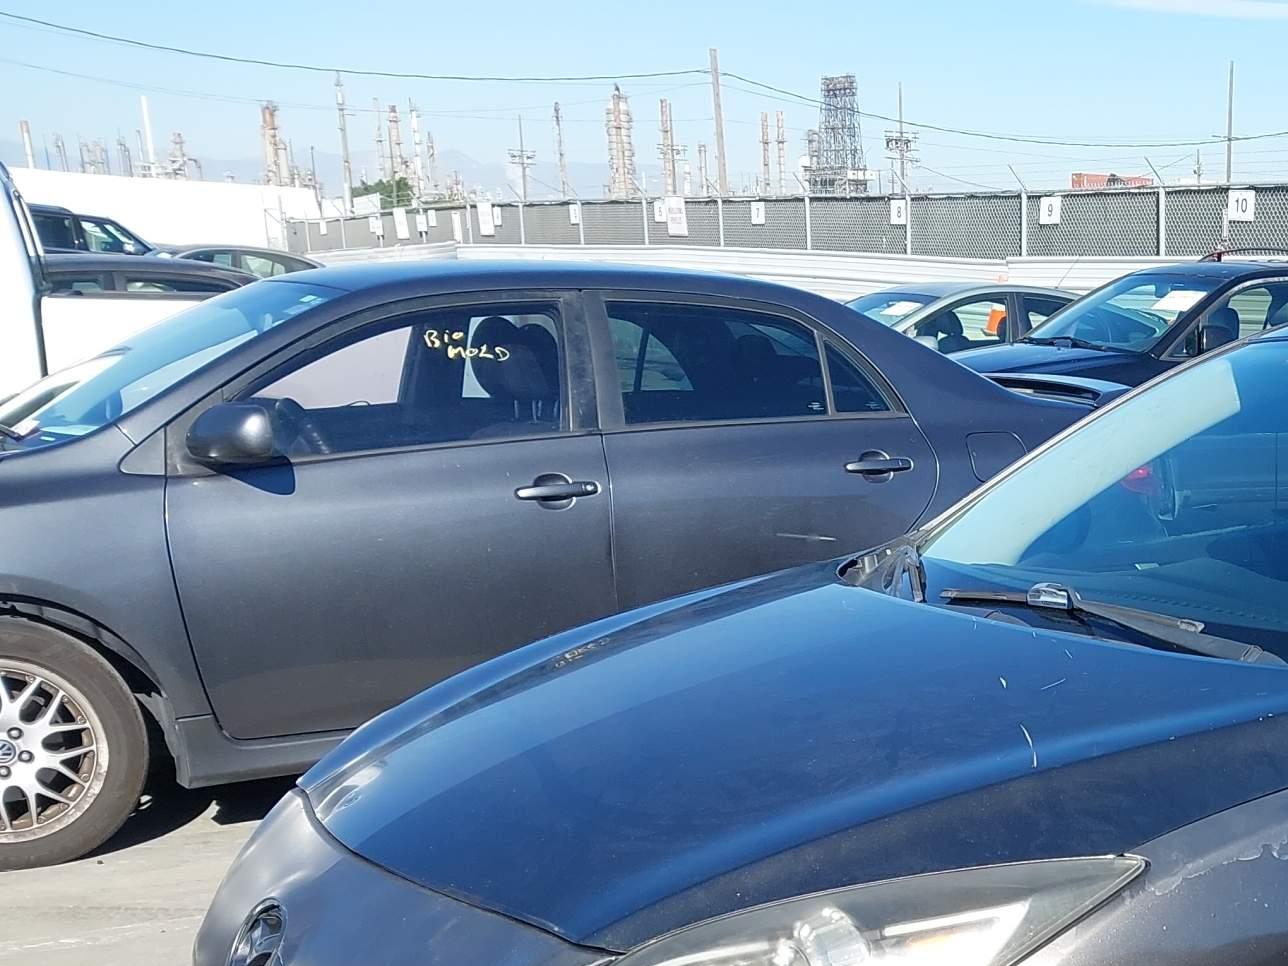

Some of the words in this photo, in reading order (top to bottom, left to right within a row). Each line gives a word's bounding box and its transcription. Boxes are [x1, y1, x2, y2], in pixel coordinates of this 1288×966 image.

[896, 206, 903, 218] 8
[1047, 203, 1054, 217] 9
[1235, 197, 1248, 213] 10
